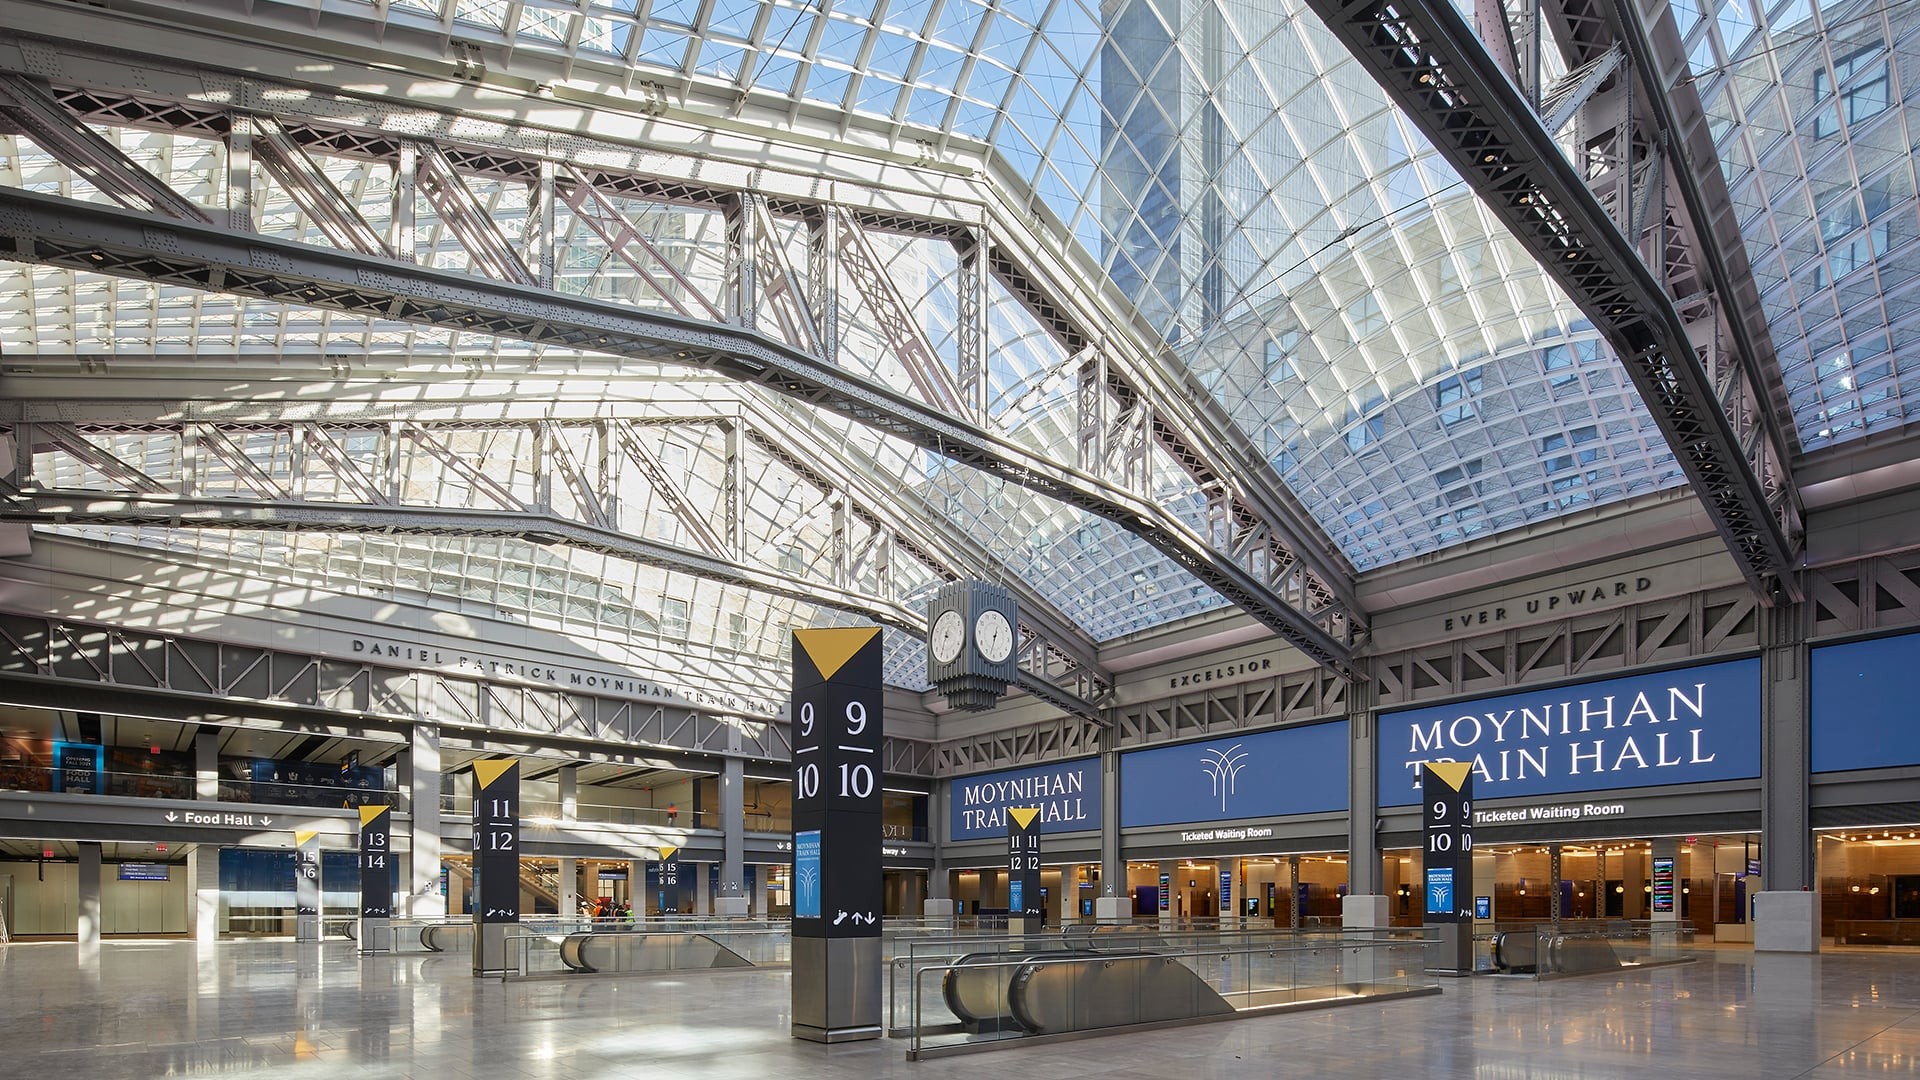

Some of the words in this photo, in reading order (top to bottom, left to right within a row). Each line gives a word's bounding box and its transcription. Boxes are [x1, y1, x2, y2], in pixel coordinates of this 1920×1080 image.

[1444, 607, 1508, 632] EVER
[1526, 577, 1652, 614] UPWARD
[353, 640, 443, 665] DANIEL
[459, 655, 556, 681] PATRICK
[570, 672, 673, 698] MOYNIHAN
[684, 690, 737, 708] TRAIN
[746, 700, 785, 715] HALL
[1170, 659, 1271, 689] EXCELSIOR
[800, 701, 815, 737] 9
[845, 700, 867, 736] 9
[1409, 683, 1706, 753] MOYNIHAN
[1405, 746, 1549, 790] TAIN
[1568, 728, 1716, 776] HALL
[796, 762, 820, 800] 10
[838, 763, 874, 799] 10
[964, 770, 1083, 806] MOYNIHAN
[490, 799, 510, 819] 11
[963, 804, 1022, 830] TRAI
[1433, 801, 1447, 820] 9
[1463, 801, 1470, 820] 9
[1475, 809, 1527, 823] Ticketed
[1530, 806, 1580, 819] Waiting
[1584, 804, 1625, 817] Room
[185, 812, 220, 825] Food
[224, 814, 253, 826] Hall
[368, 833, 385, 846] 13
[490, 831, 513, 850] 12
[1011, 835, 1020, 848] 11
[1028, 835, 1037, 848] 11
[1181, 830, 1214, 841] Ticketed
[1215, 828, 1246, 840] Waiting
[1247, 827, 1272, 837] Room
[1428, 832, 1452, 852] 10
[1461, 832, 1472, 852] 10
[302, 851, 316, 862] 15
[367, 855, 386, 869] 14
[1010, 856, 1021, 870] 12
[1028, 856, 1039, 870] 12
[303, 867, 316, 878] 16
[667, 863, 677, 872] 15
[667, 876, 677, 885] 16
